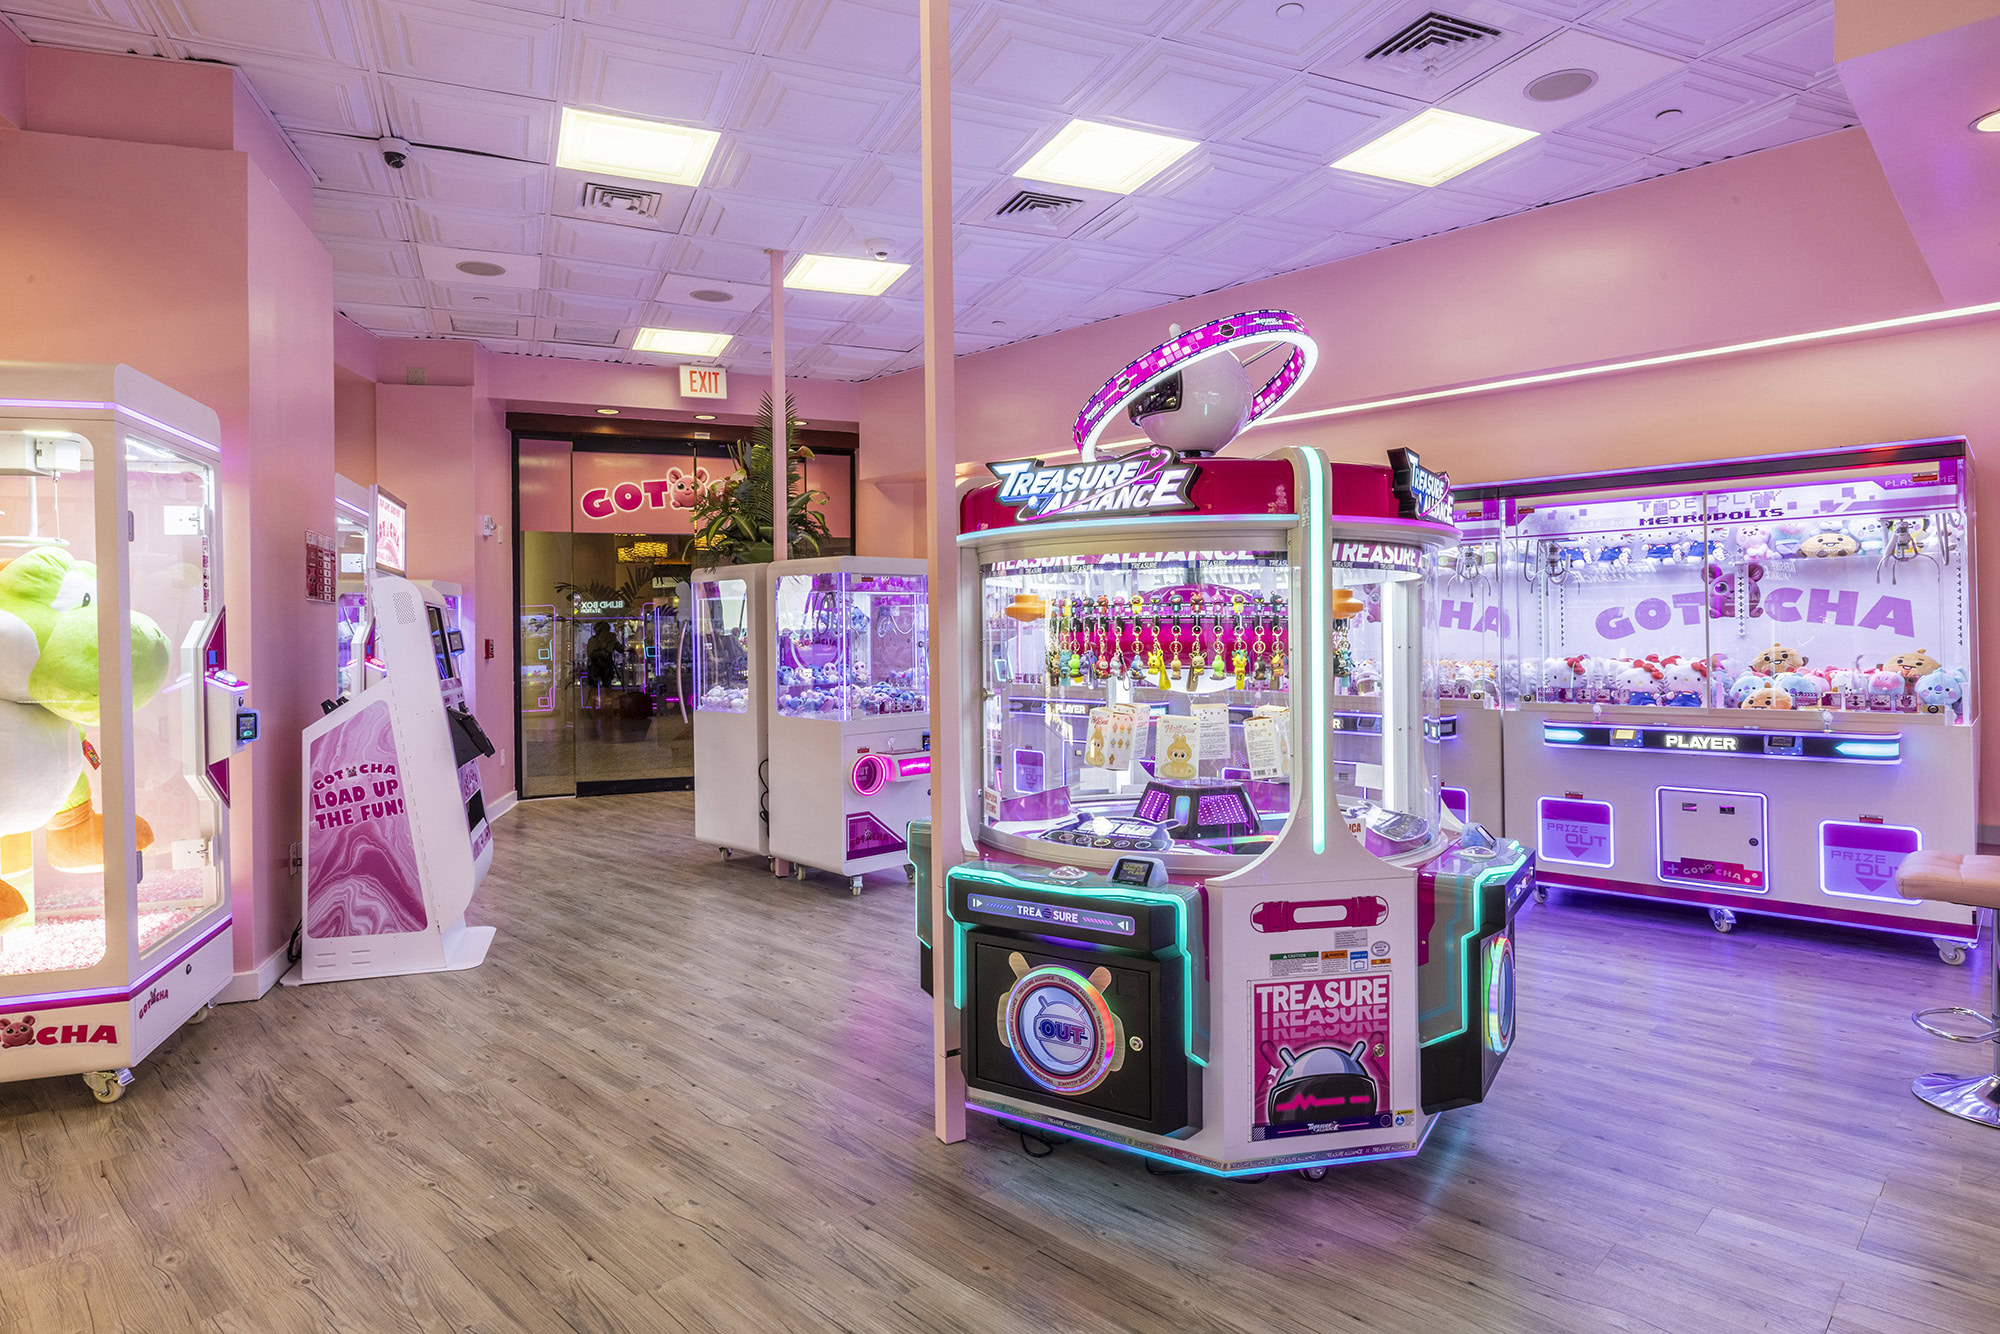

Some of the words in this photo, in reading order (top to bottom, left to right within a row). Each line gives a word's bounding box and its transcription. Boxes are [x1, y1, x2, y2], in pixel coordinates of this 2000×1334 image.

[689, 370, 720, 394] EXIT
[991, 460, 1150, 498] TREASURE
[1407, 451, 1446, 499] TREASURE
[582, 480, 669, 518] GOT
[1037, 467, 1190, 516] ALLIANCE
[1421, 493, 1455, 526] ALLIANCE
[1639, 508, 1785, 526] METROPOLIS
[1332, 543, 1416, 567] TREASURE
[1595, 591, 1706, 640] GOT
[1763, 587, 1915, 638] CHA
[1056, 704, 1086, 714] PLAYER
[1665, 735, 1737, 751] PLAYER
[313, 769, 344, 790] GOT
[359, 764, 396, 775] CHA
[313, 785, 366, 810] LOAD
[372, 779, 399, 798] UP
[315, 808, 354, 830] THE
[360, 798, 404, 821] FUN!
[1546, 822, 1589, 834] PRIZE
[1565, 833, 1607, 848] OUT
[1831, 850, 1887, 864] PRIZE
[1683, 866, 1706, 875] GOT
[1715, 868, 1741, 881] CHA
[1855, 862, 1899, 878] OU
[1256, 978, 1388, 1013] TREASURE
[36, 1024, 118, 1046] CHA
[1039, 1018, 1086, 1046] OUT
